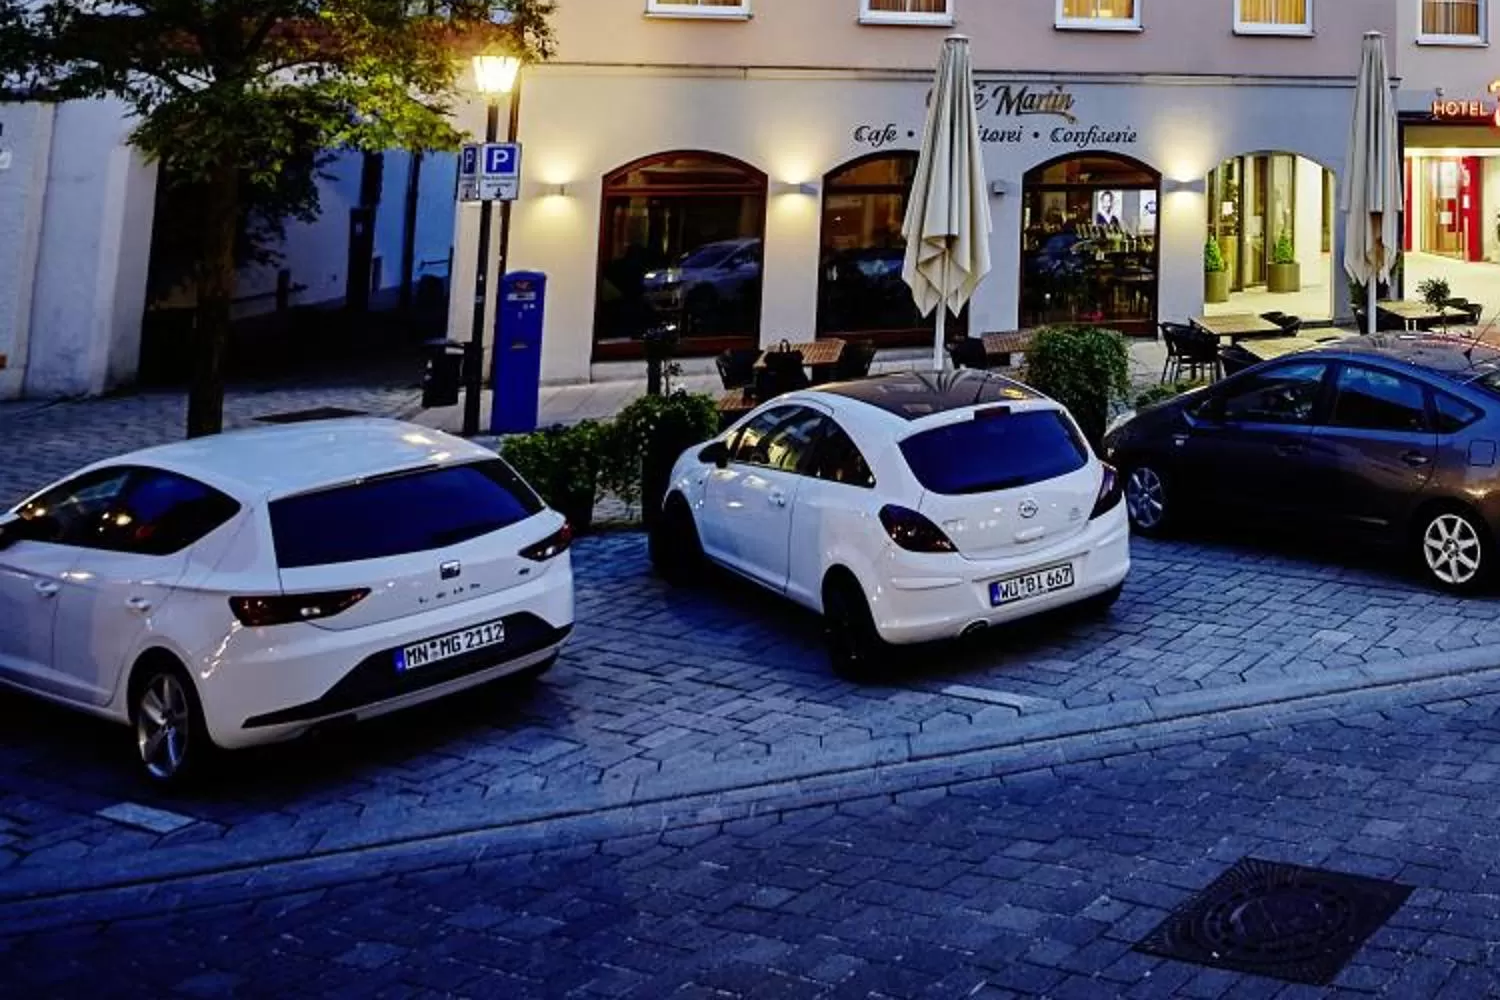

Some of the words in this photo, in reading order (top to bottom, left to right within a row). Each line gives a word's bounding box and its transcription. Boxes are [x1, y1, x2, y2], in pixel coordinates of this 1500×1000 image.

[992, 85, 1078, 124] Martin
[1433, 100, 1489, 117] HOTEL
[1050, 123, 1138, 148] Confiserie
[491, 149, 509, 171] P
[405, 643, 429, 667] MN
[440, 635, 461, 656] MG
[465, 623, 505, 649] 2112
